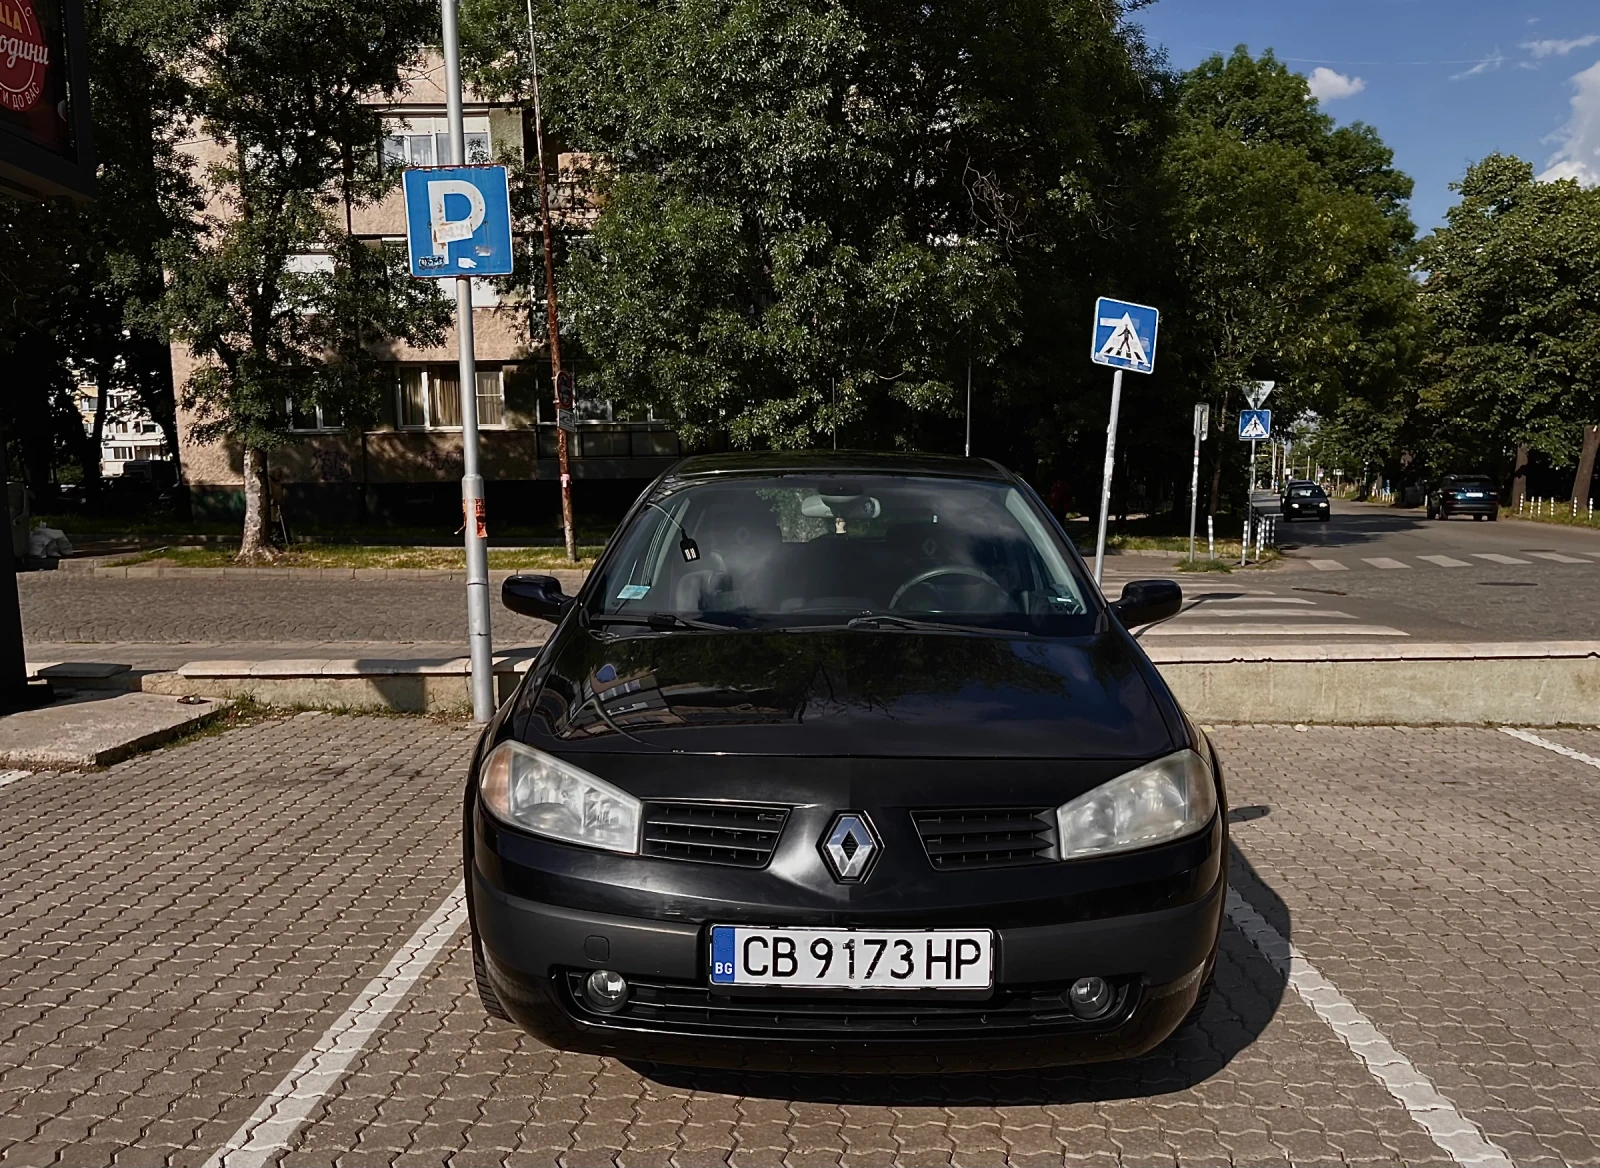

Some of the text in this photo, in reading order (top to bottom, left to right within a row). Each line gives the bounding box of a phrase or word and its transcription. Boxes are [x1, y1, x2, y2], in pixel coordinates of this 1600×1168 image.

[12, 94, 25, 110] ДО
[25, 82, 40, 105] ВАС
[427, 180, 486, 265] P
[715, 961, 733, 975] BG
[809, 937, 915, 980] 9173
